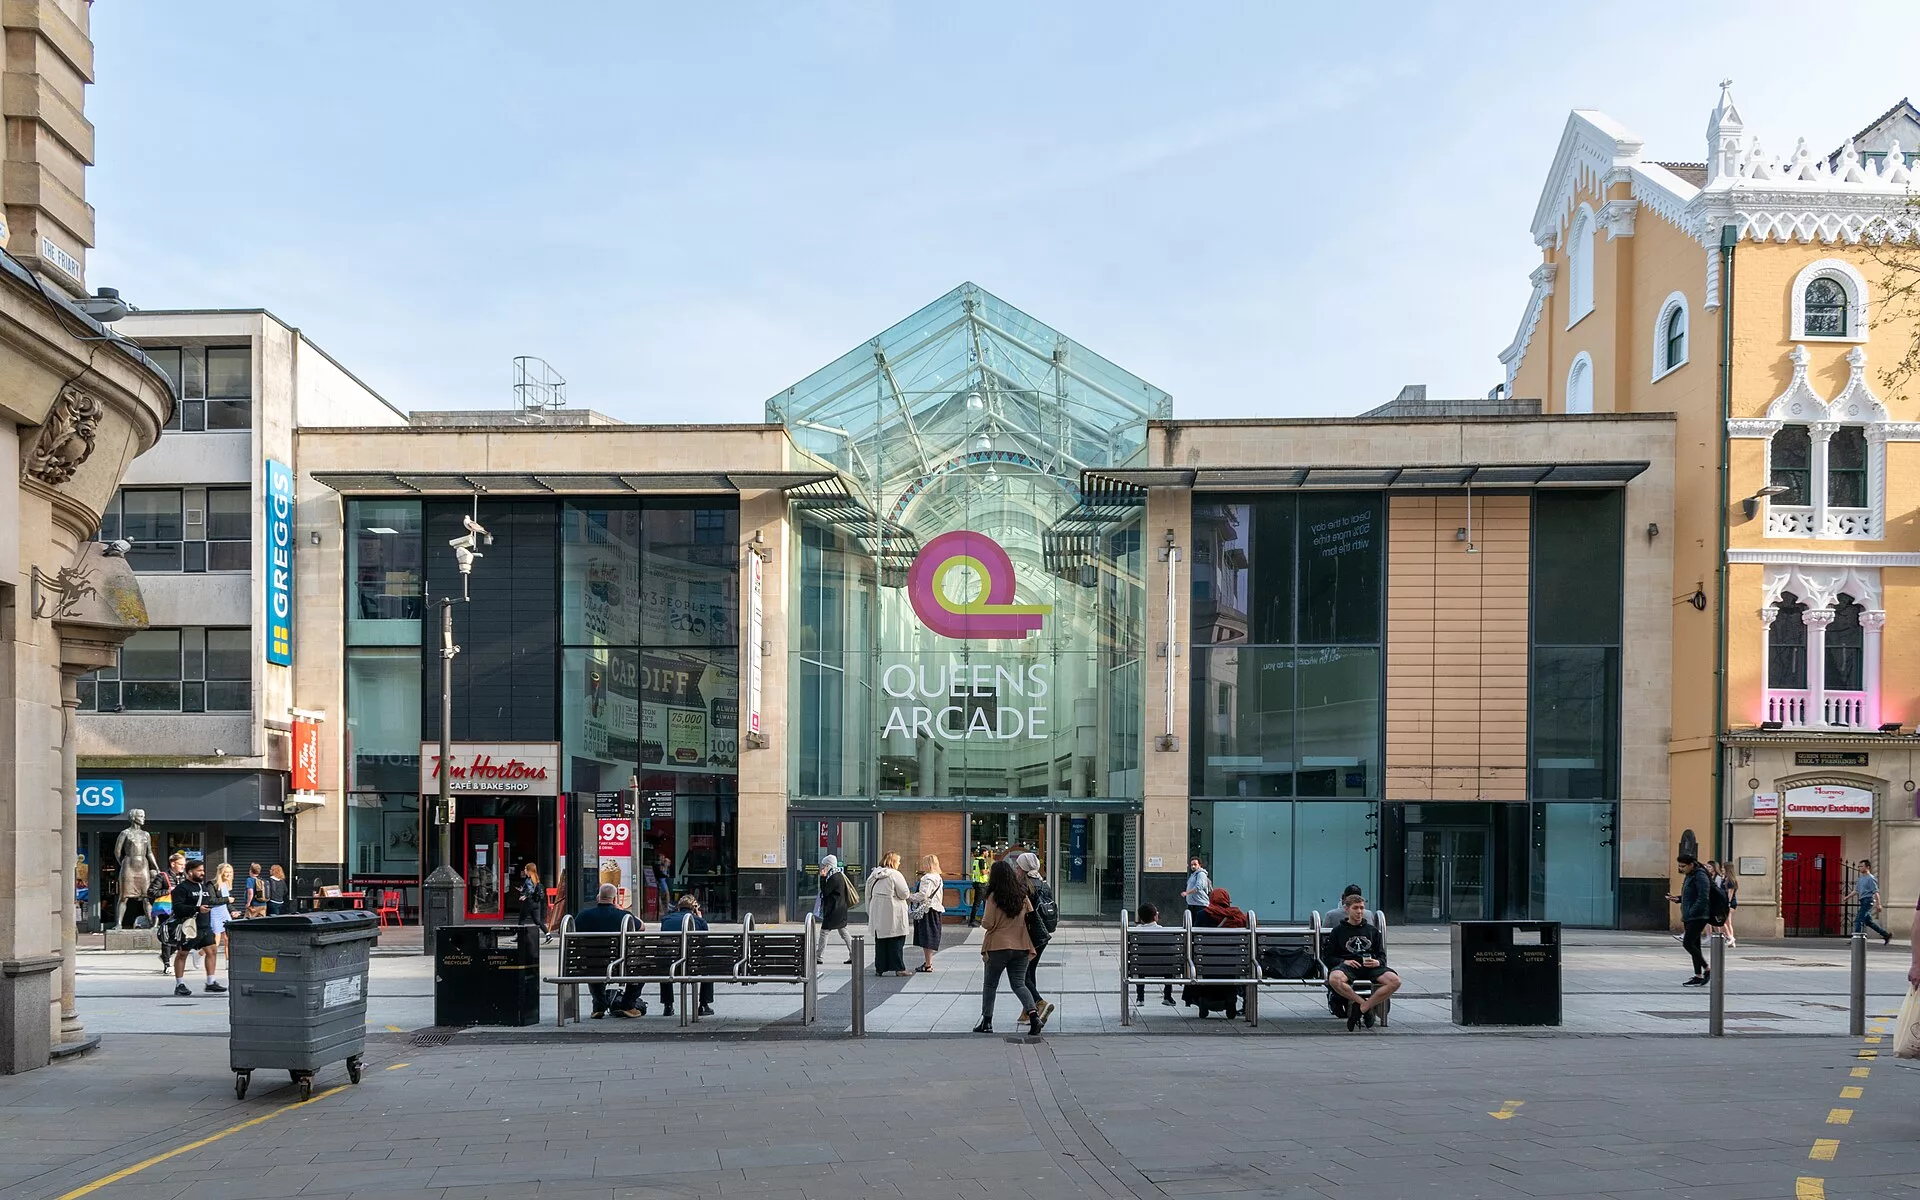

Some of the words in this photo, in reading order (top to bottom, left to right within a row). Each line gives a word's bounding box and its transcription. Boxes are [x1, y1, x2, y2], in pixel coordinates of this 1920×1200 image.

[44, 239, 55, 261] THE
[57, 250, 79, 278] FRIARY
[274, 471, 289, 618] GREGGS
[650, 591, 658, 606] 3
[660, 595, 707, 613] PEOPLE
[611, 656, 690, 695] CARDIFF
[883, 664, 1048, 700] QUEENS
[672, 712, 703, 725] 75,000
[882, 706, 1049, 740] ARCADE
[299, 743, 309, 769] Tim
[307, 729, 317, 785] Hortons
[431, 755, 467, 779] Tm
[449, 781, 472, 791] CAFÉ
[472, 782, 480, 790] &
[481, 782, 504, 791] BAKE
[505, 782, 529, 791] SHOP
[1787, 803, 1828, 816] Currency
[1828, 803, 1871, 814] Exchange
